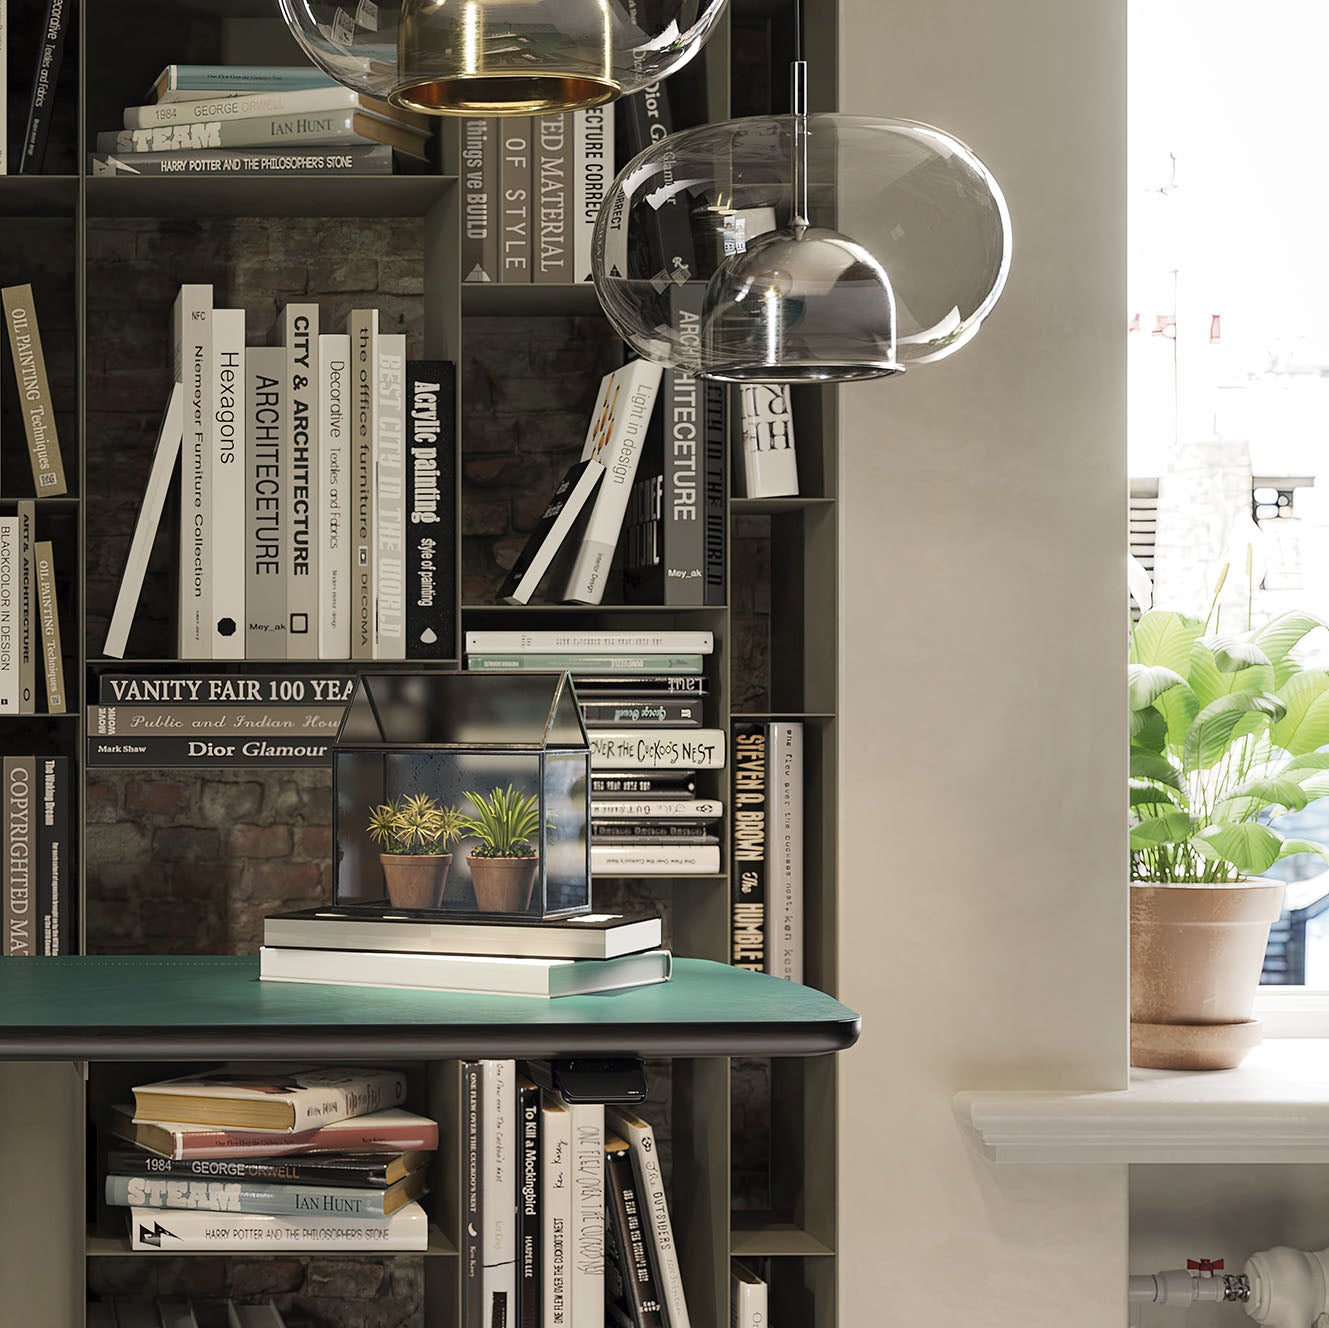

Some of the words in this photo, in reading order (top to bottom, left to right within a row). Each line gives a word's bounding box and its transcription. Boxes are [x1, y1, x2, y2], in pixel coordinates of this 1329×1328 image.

[293, 315, 310, 369] CITY
[292, 374, 309, 391] &
[215, 352, 240, 464] Hexagons
[632, 384, 653, 419] Light
[626, 421, 643, 436] in
[612, 438, 637, 485] design
[255, 374, 280, 575] ARCHITECETURE
[293, 399, 309, 576] ARCHITECTURE
[109, 680, 203, 702] VANITY
[208, 680, 263, 702] FAIR
[269, 680, 306, 702] 100
[129, 714, 185, 729] Public
[191, 715, 227, 729] and
[233, 715, 295, 728] Indian
[97, 744, 122, 753] Mark
[123, 744, 147, 753] Shaw
[187, 740, 236, 758] Dior
[241, 741, 328, 757] Glamour
[734, 734, 765, 790] STEVEN
[734, 811, 765, 862] BROWN
[739, 871, 760, 895] The
[734, 902, 765, 962] HUMBLE
[524, 1105, 538, 1120] To
[524, 1121, 538, 1139] Kill
[144, 1157, 174, 1174] 1984
[191, 1159, 245, 1176] GEORGE
[128, 1177, 242, 1211] STEAM
[522, 1149, 538, 1216] Mockingbird
[295, 1193, 319, 1210] IAN
[323, 1192, 362, 1213] HUNT
[205, 1228, 231, 1240] HARRY
[233, 1228, 264, 1240] POTTER
[266, 1228, 283, 1239] AND
[284, 1228, 300, 1238] THE
[365, 1228, 389, 1240] STONE
